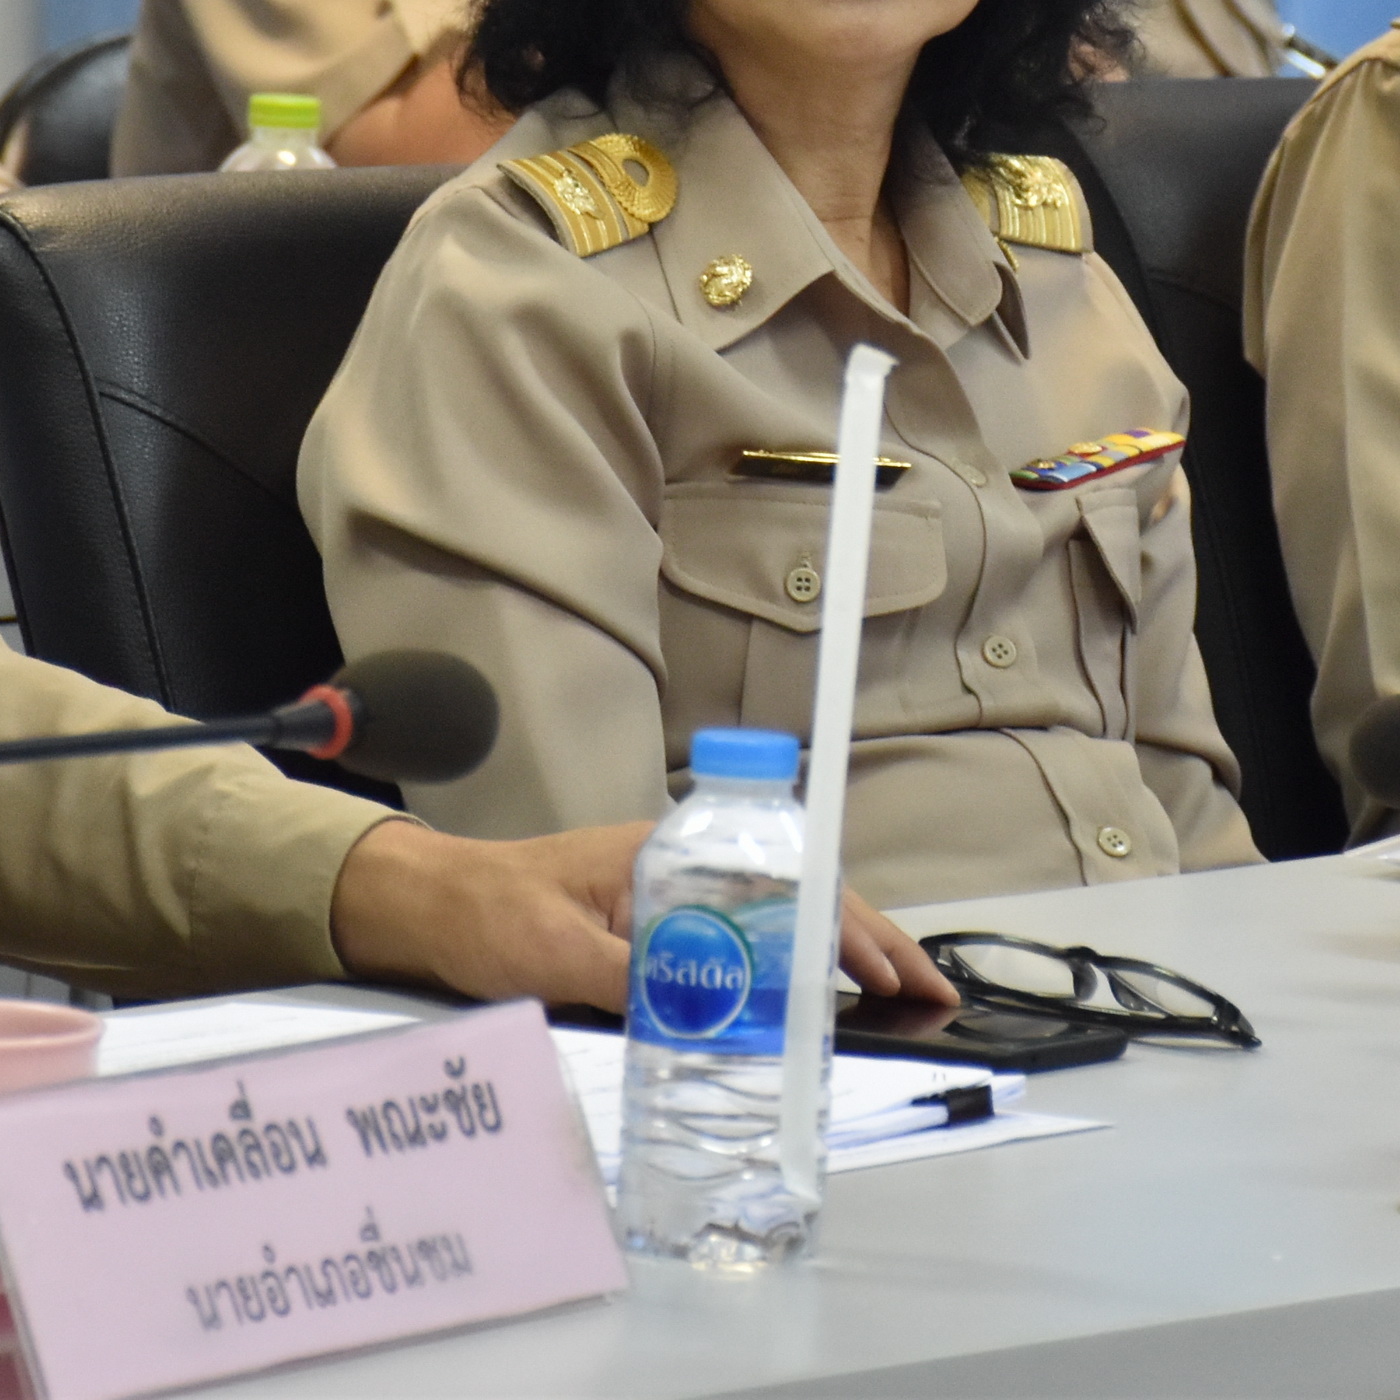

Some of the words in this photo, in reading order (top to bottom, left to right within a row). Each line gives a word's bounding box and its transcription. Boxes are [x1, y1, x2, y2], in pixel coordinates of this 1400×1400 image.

[63, 1079, 329, 1214] นายคำเคลื่อน
[185, 1205, 474, 1332] นายอำเภอชื่นชม
